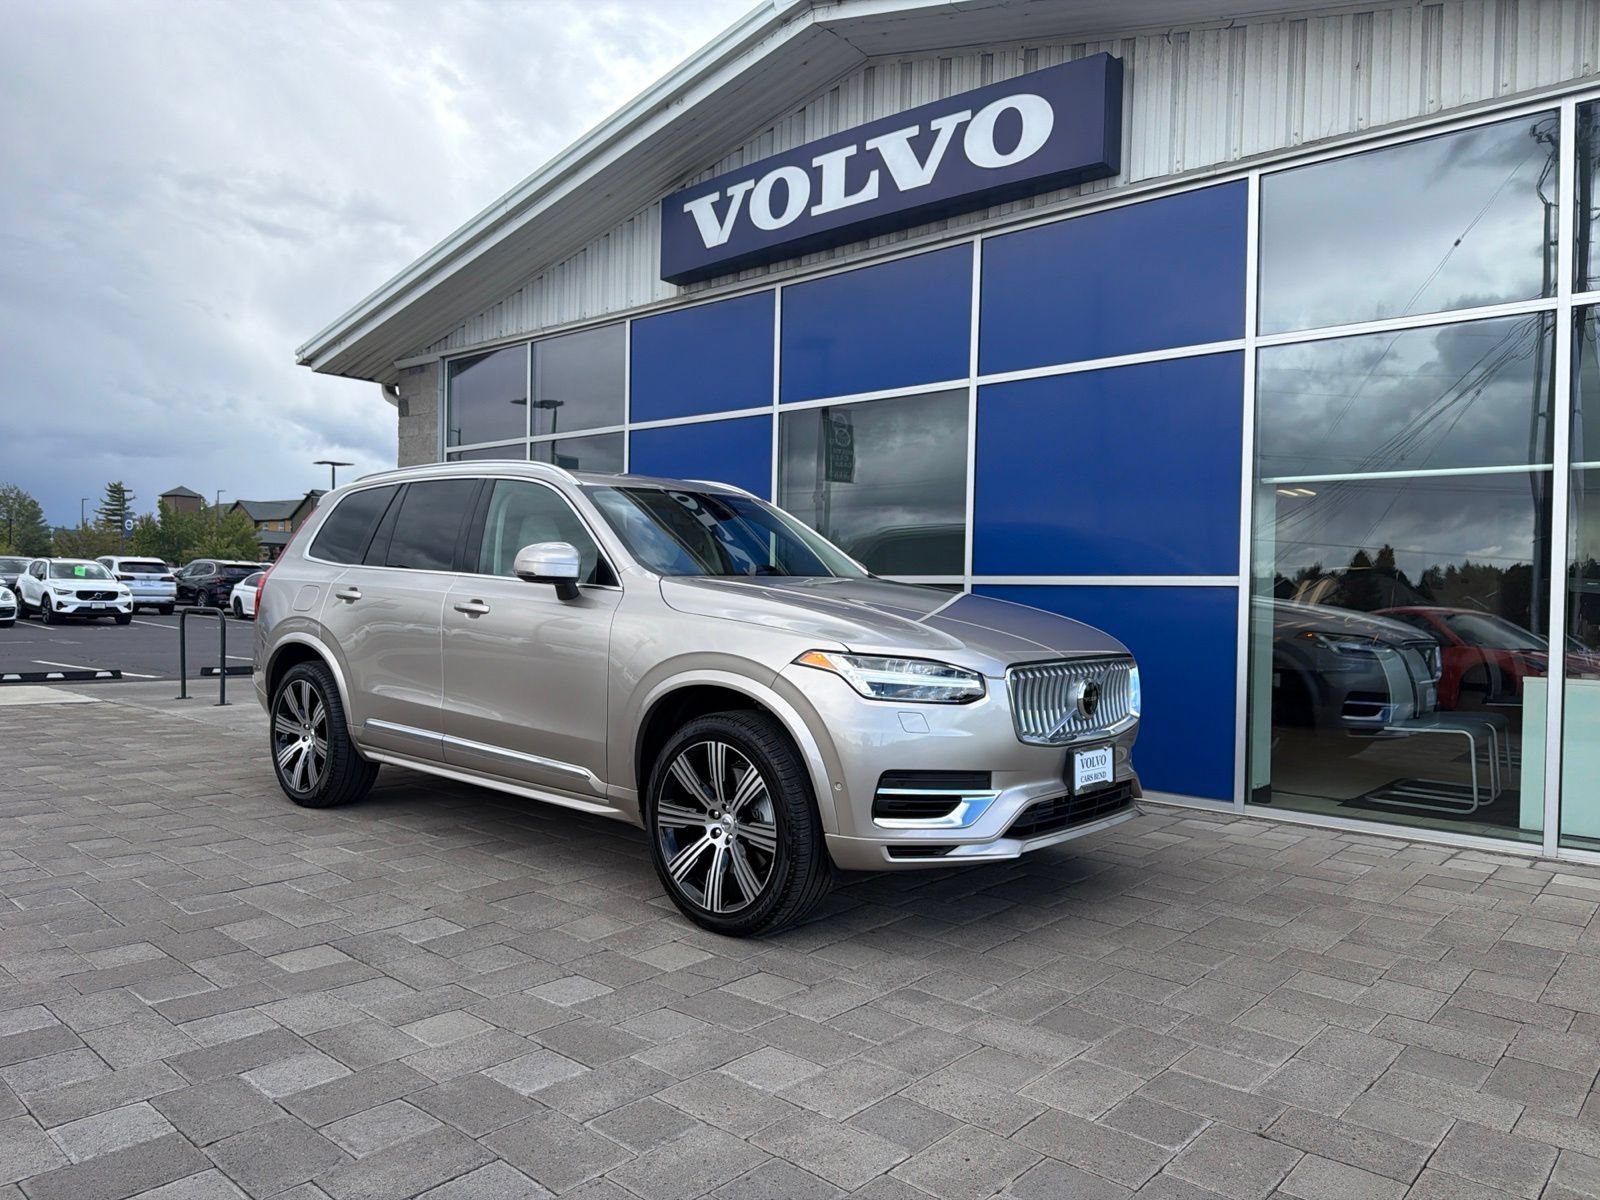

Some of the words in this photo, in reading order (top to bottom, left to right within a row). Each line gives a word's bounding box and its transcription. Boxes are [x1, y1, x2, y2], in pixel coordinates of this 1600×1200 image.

[683, 93, 1055, 249] VOLVO
[1080, 754, 1107, 769] VOLVO
[1080, 774, 1094, 783] CARS
[1094, 771, 1107, 781] BEND
